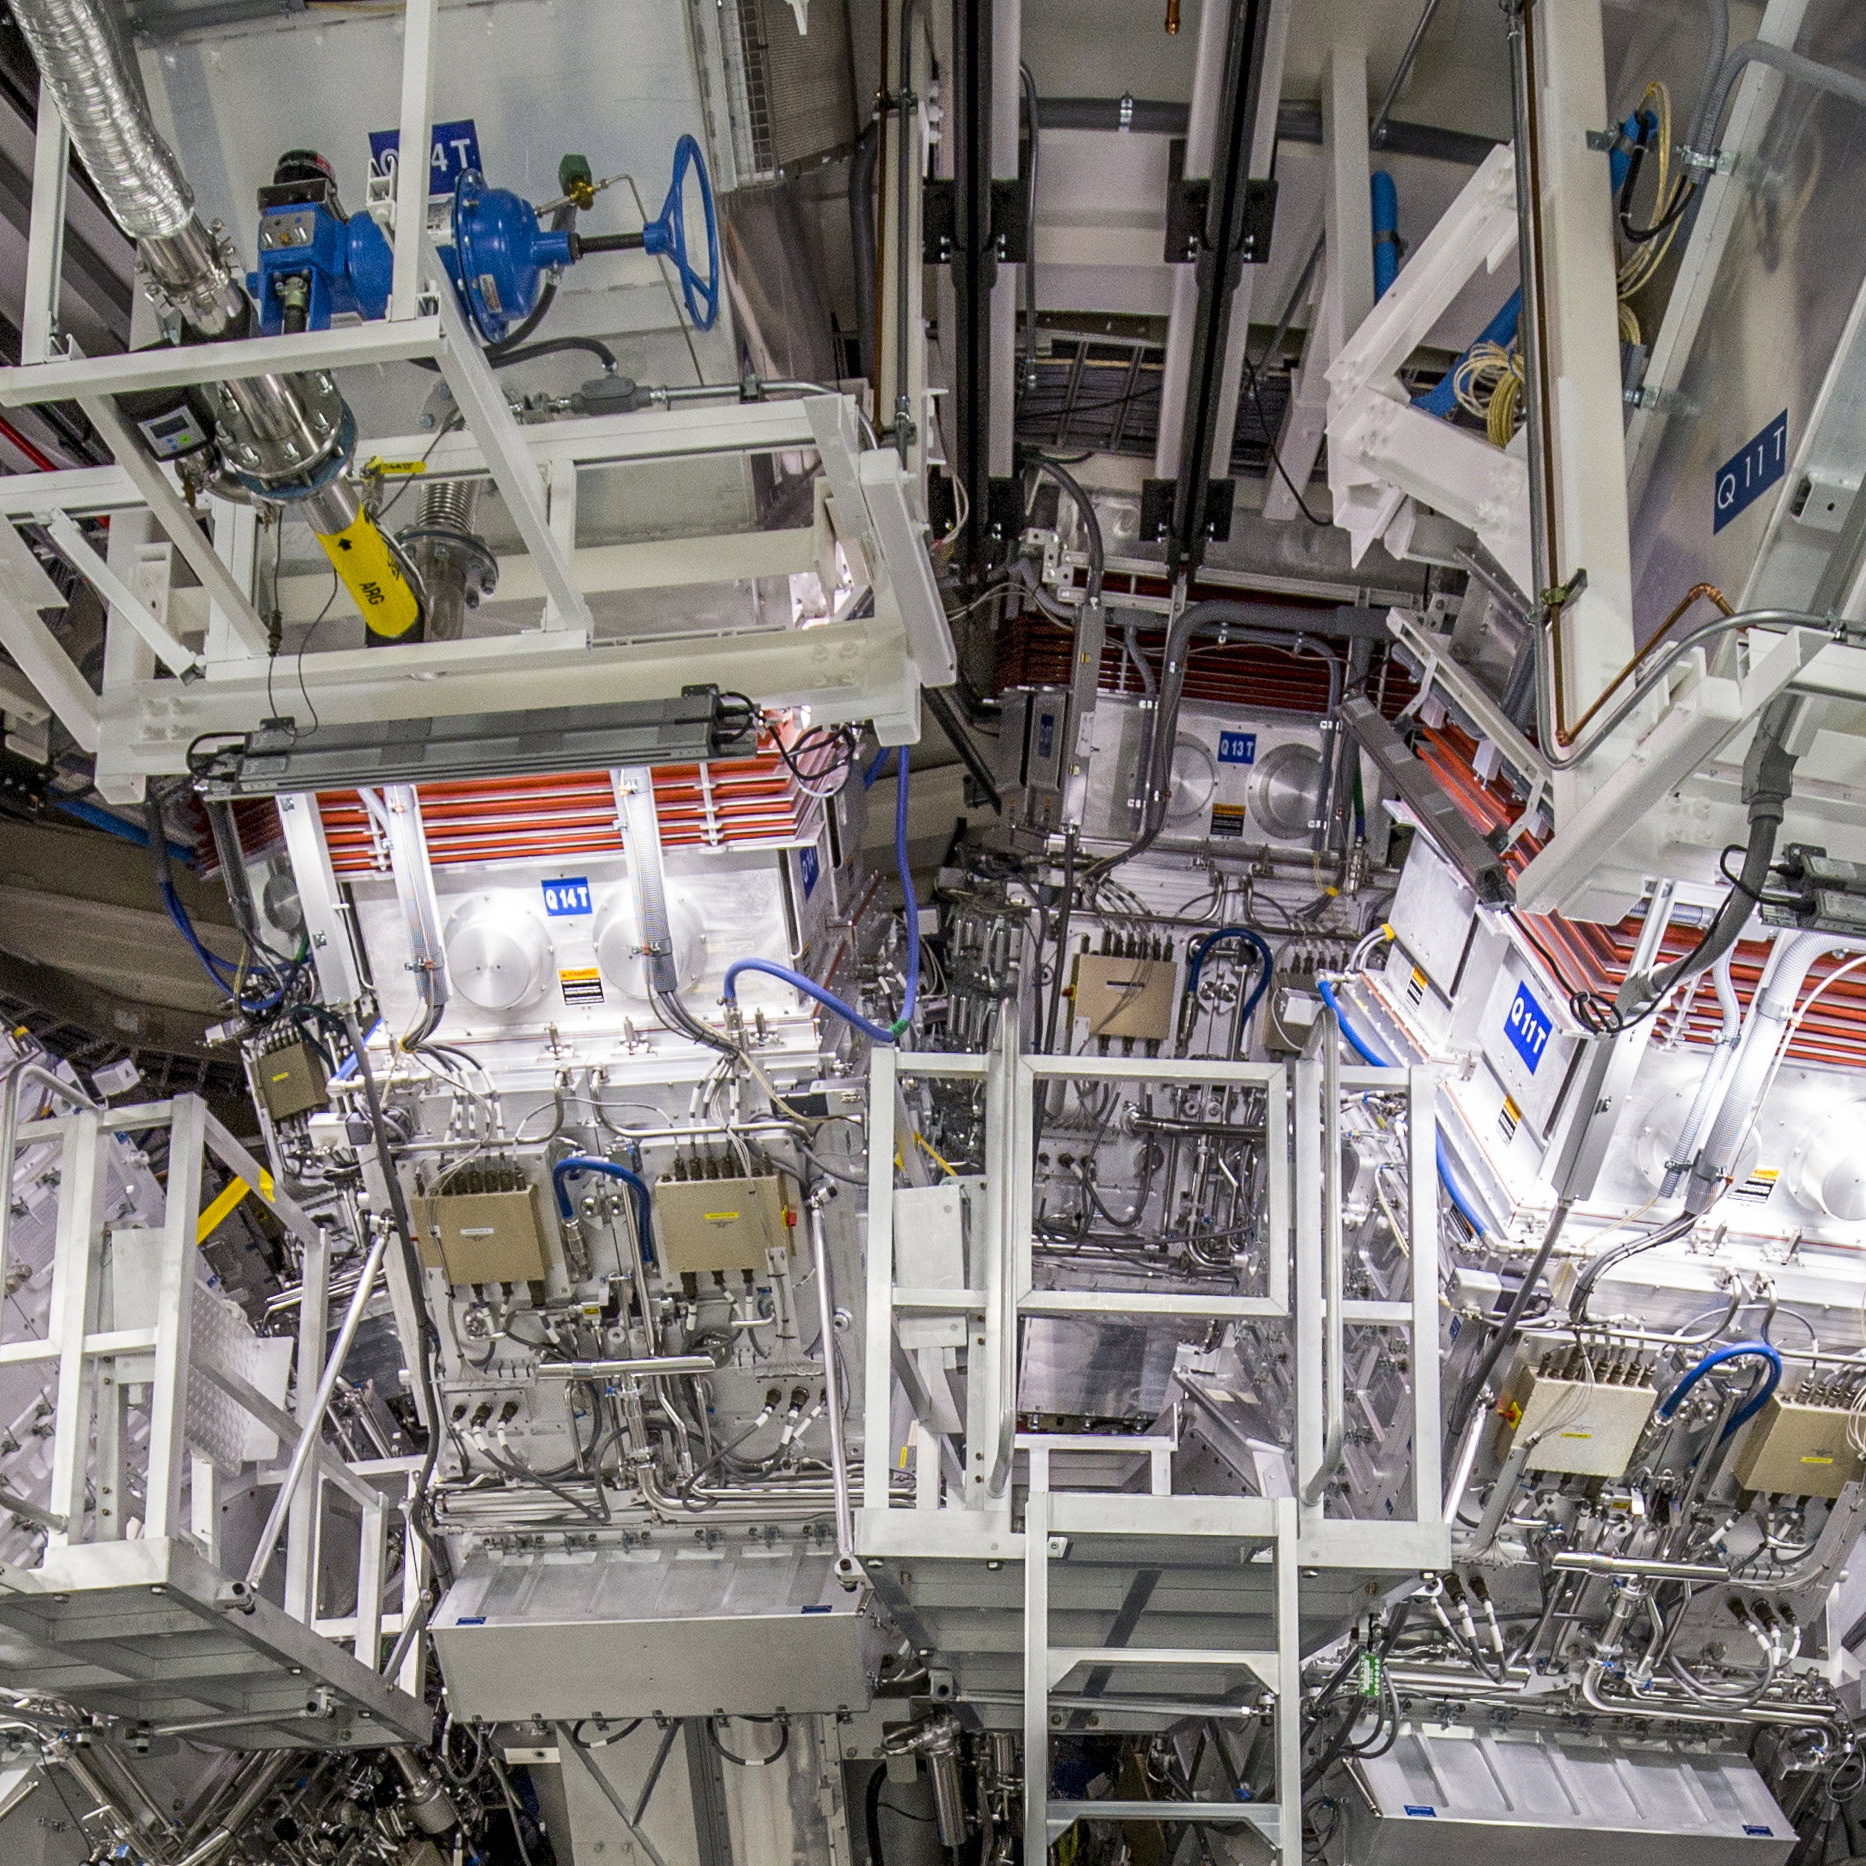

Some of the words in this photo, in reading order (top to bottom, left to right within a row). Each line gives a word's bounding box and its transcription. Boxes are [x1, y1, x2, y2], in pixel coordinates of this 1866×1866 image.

[451, 138, 472, 169] T
[1717, 472, 1737, 511] Q
[1744, 443, 1764, 488] 11
[1773, 424, 1786, 461] T
[359, 580, 386, 607] ARG
[1220, 738, 1230, 757] Q
[1231, 740, 1245, 758] 13
[1245, 740, 1255, 758] T
[544, 887, 560, 912] Q
[559, 887, 578, 910] 14
[576, 885, 589, 909] T
[1511, 996, 1526, 1028] Q
[1521, 1012, 1538, 1044] 11
[1532, 1026, 1547, 1055] T
